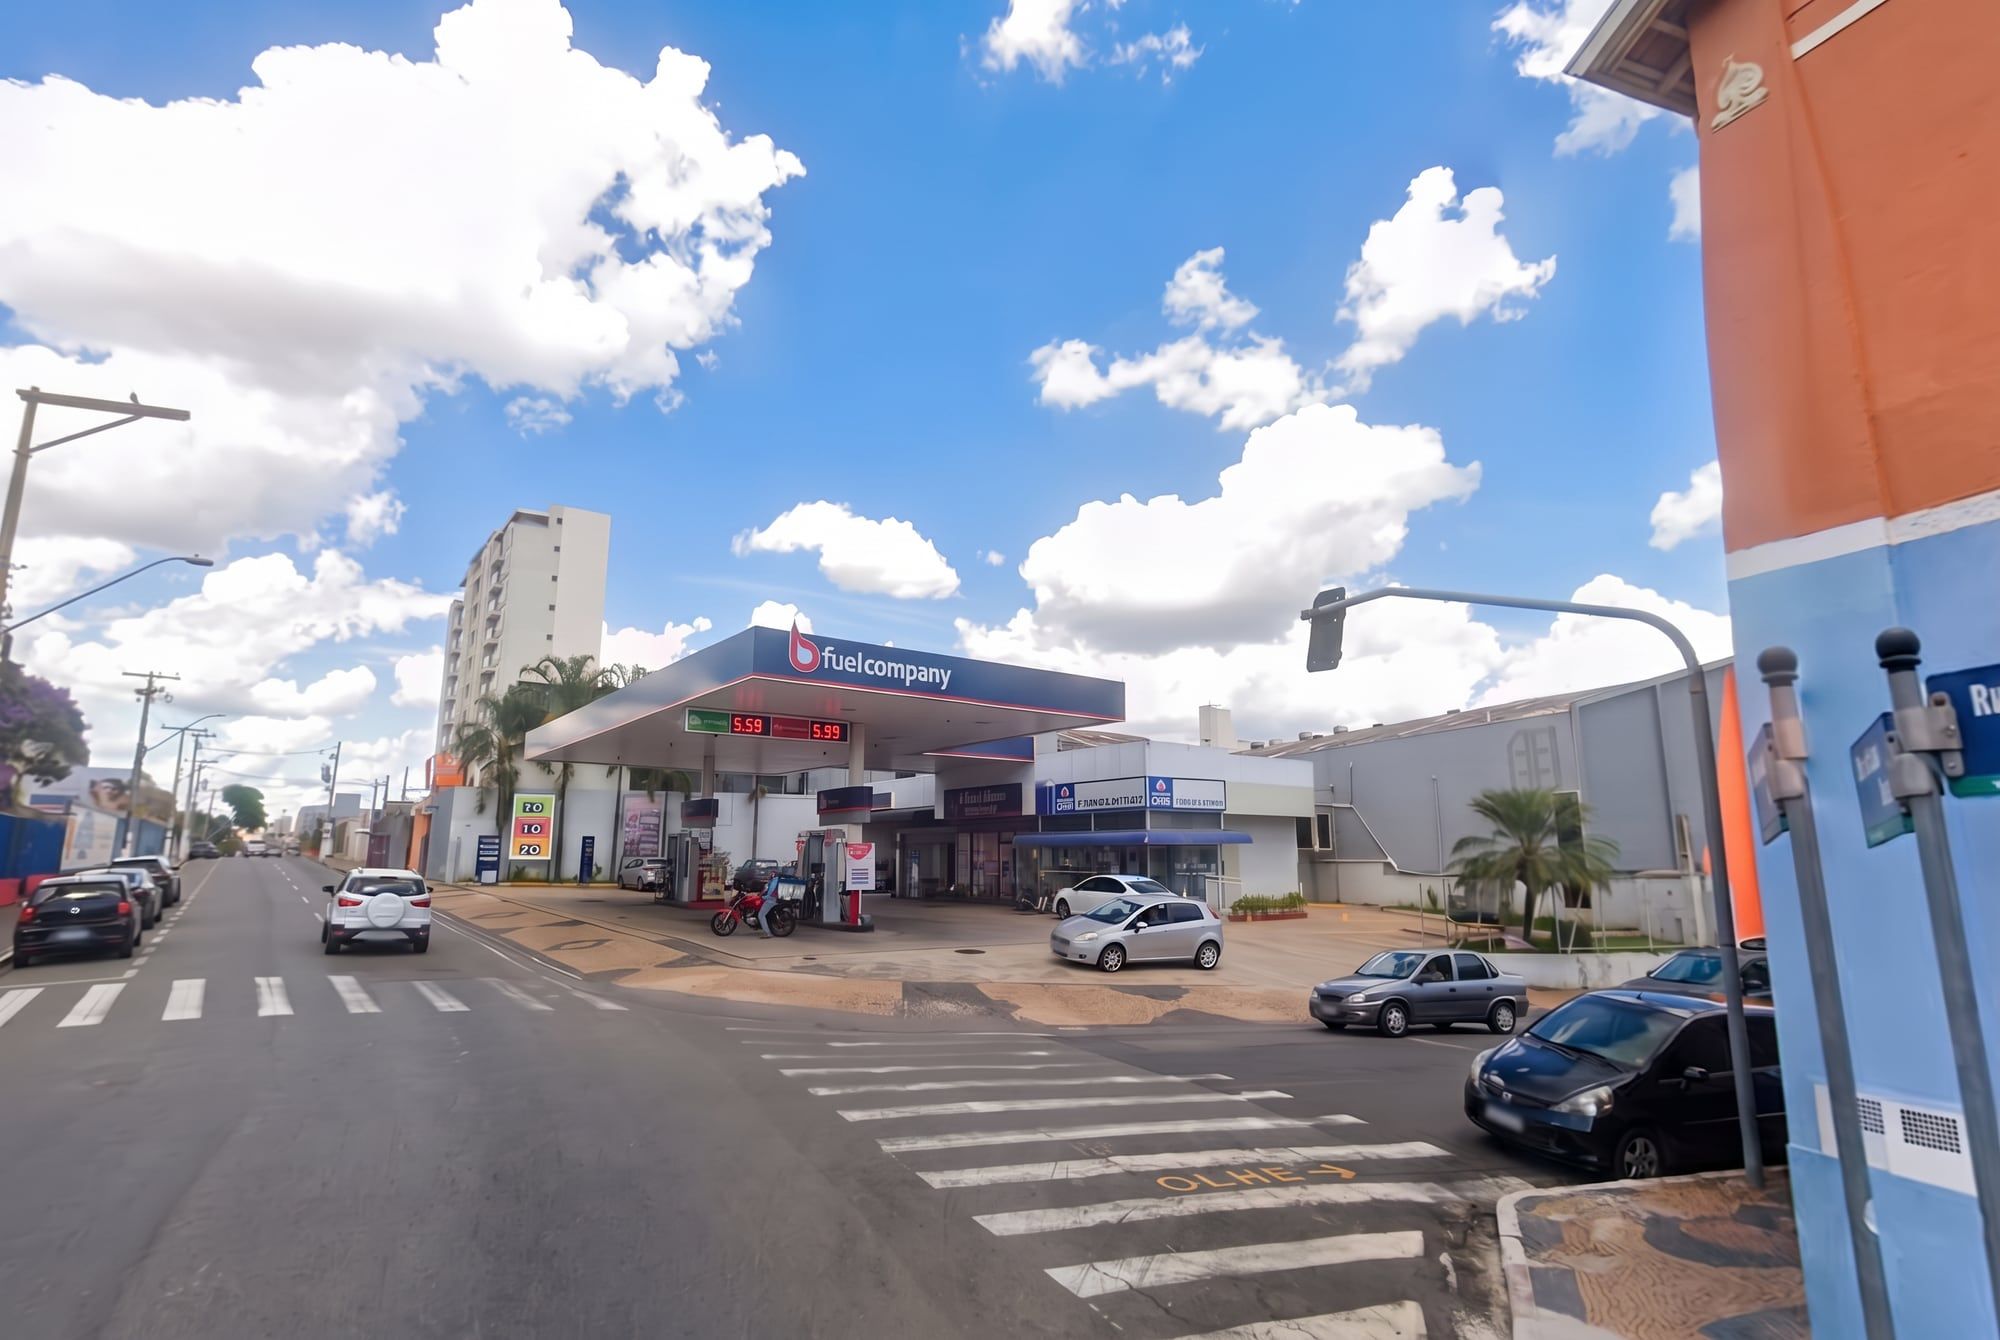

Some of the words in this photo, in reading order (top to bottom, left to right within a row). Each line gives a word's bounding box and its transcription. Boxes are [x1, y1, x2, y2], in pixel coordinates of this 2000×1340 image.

[822, 647, 952, 690] fuelcompany
[733, 717, 763, 733] 5.59
[812, 724, 840, 740] 5.99
[522, 824, 542, 834] 10
[520, 845, 540, 855] 20
[1156, 1167, 1306, 1192] OLHE
